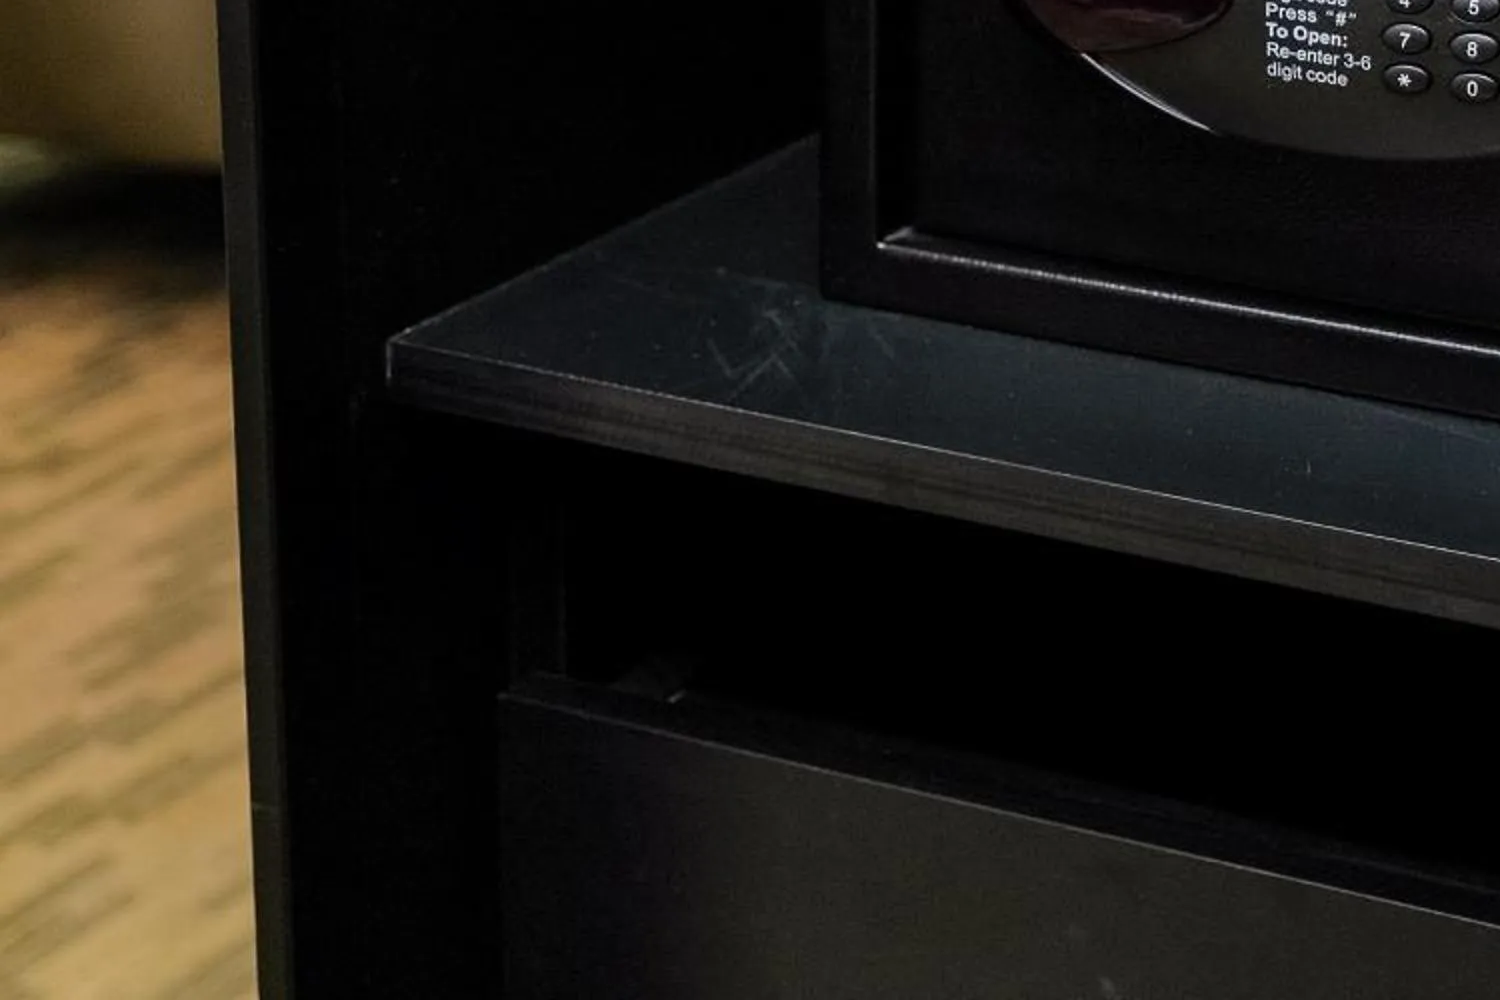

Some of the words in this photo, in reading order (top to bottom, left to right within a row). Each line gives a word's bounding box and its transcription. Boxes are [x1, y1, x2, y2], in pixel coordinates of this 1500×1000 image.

[1266, 4, 1317, 22] Press
[1468, 0, 1479, 14] 5
[1266, 22, 1288, 39] To
[1293, 26, 1348, 48] Open:
[1400, 33, 1409, 48] 7
[1467, 41, 1477, 57] 8
[1266, 42, 1340, 67] Re-enter
[1344, 54, 1371, 70] 3-6
[1267, 63, 1302, 82] digit
[1306, 69, 1348, 87] code
[1467, 82, 1478, 96] 0
